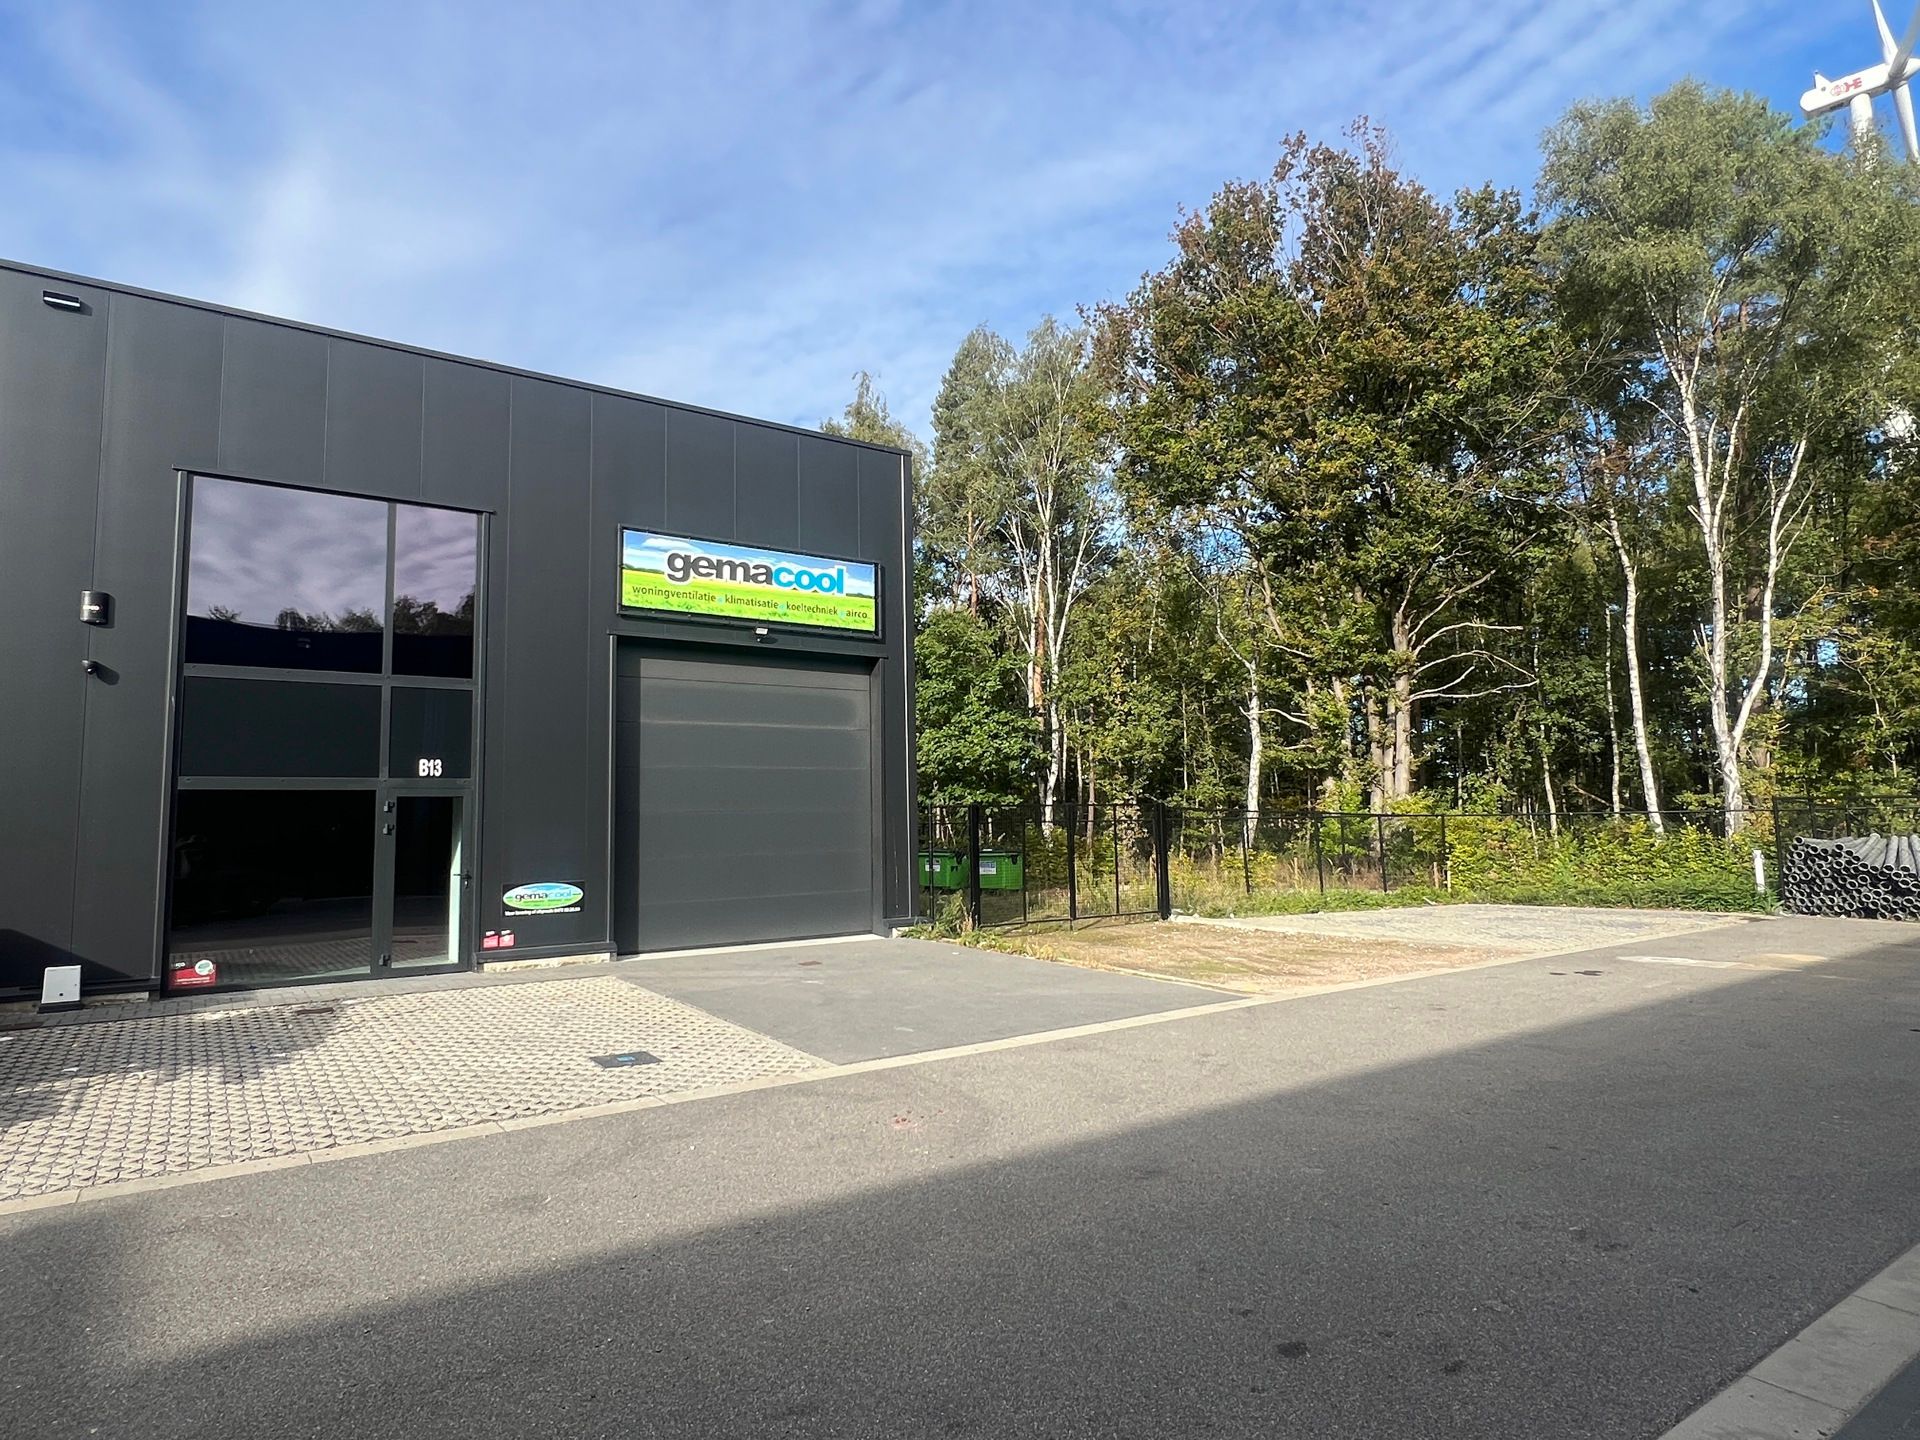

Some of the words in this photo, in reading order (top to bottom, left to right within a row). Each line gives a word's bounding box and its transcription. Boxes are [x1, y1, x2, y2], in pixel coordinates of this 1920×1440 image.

[667, 552, 844, 594] gemacool
[632, 585, 716, 602] woningventilatie
[724, 594, 779, 610] klimatisatie
[786, 602, 838, 616] koeltechniek
[846, 610, 868, 619] airco
[418, 758, 442, 777] B13
